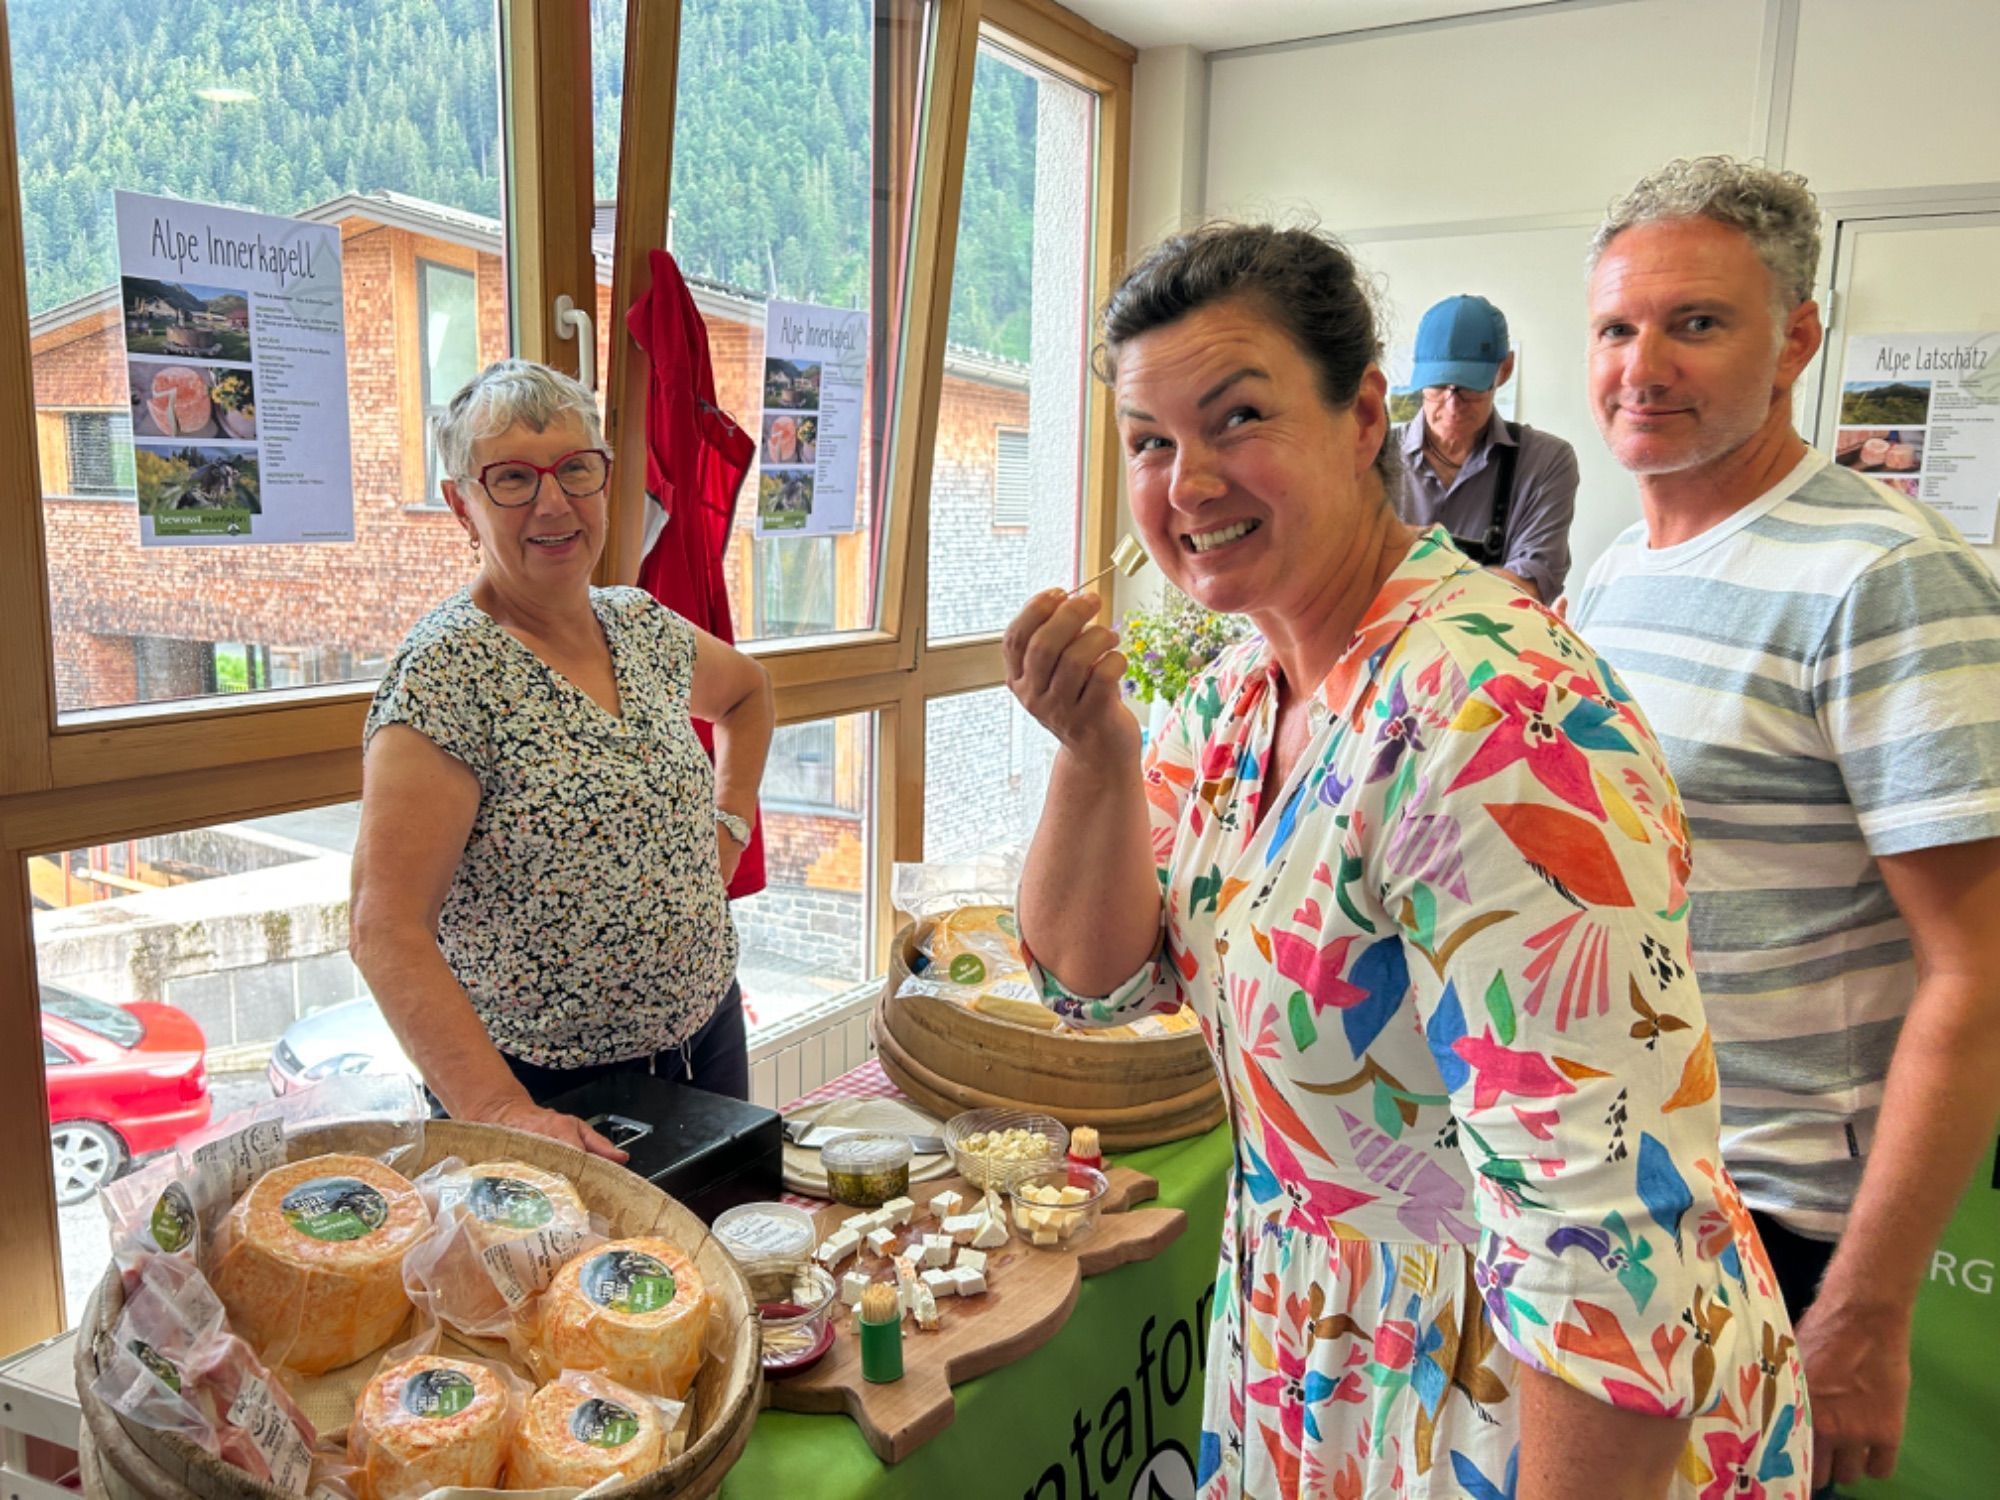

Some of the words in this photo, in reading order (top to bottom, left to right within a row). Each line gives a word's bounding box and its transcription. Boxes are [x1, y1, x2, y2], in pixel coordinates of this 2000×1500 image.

[152, 217, 199, 275] Alpe
[207, 225, 315, 287] Innerkapell
[781, 315, 806, 355] Alpe
[806, 318, 855, 357] Innerkapell
[1876, 347, 1911, 378] Alpe
[1916, 346, 1988, 371] Latschätz
